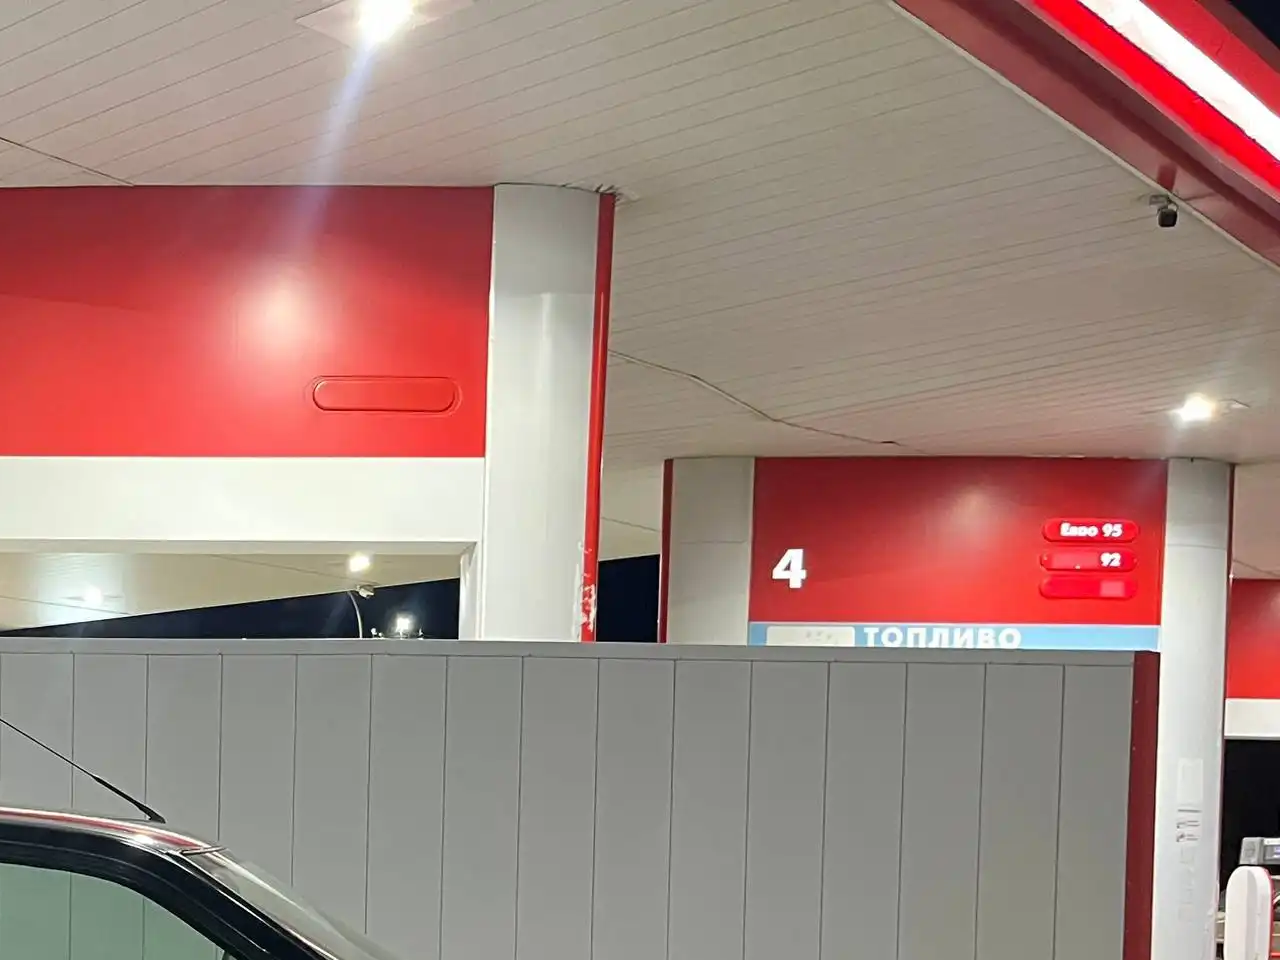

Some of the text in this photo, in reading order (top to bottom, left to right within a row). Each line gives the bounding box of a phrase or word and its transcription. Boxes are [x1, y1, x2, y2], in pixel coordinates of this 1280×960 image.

[1101, 522, 1123, 538] 95
[771, 548, 807, 589] 4
[1100, 552, 1122, 568] 92
[863, 626, 1022, 649] ТОПЛИВО
